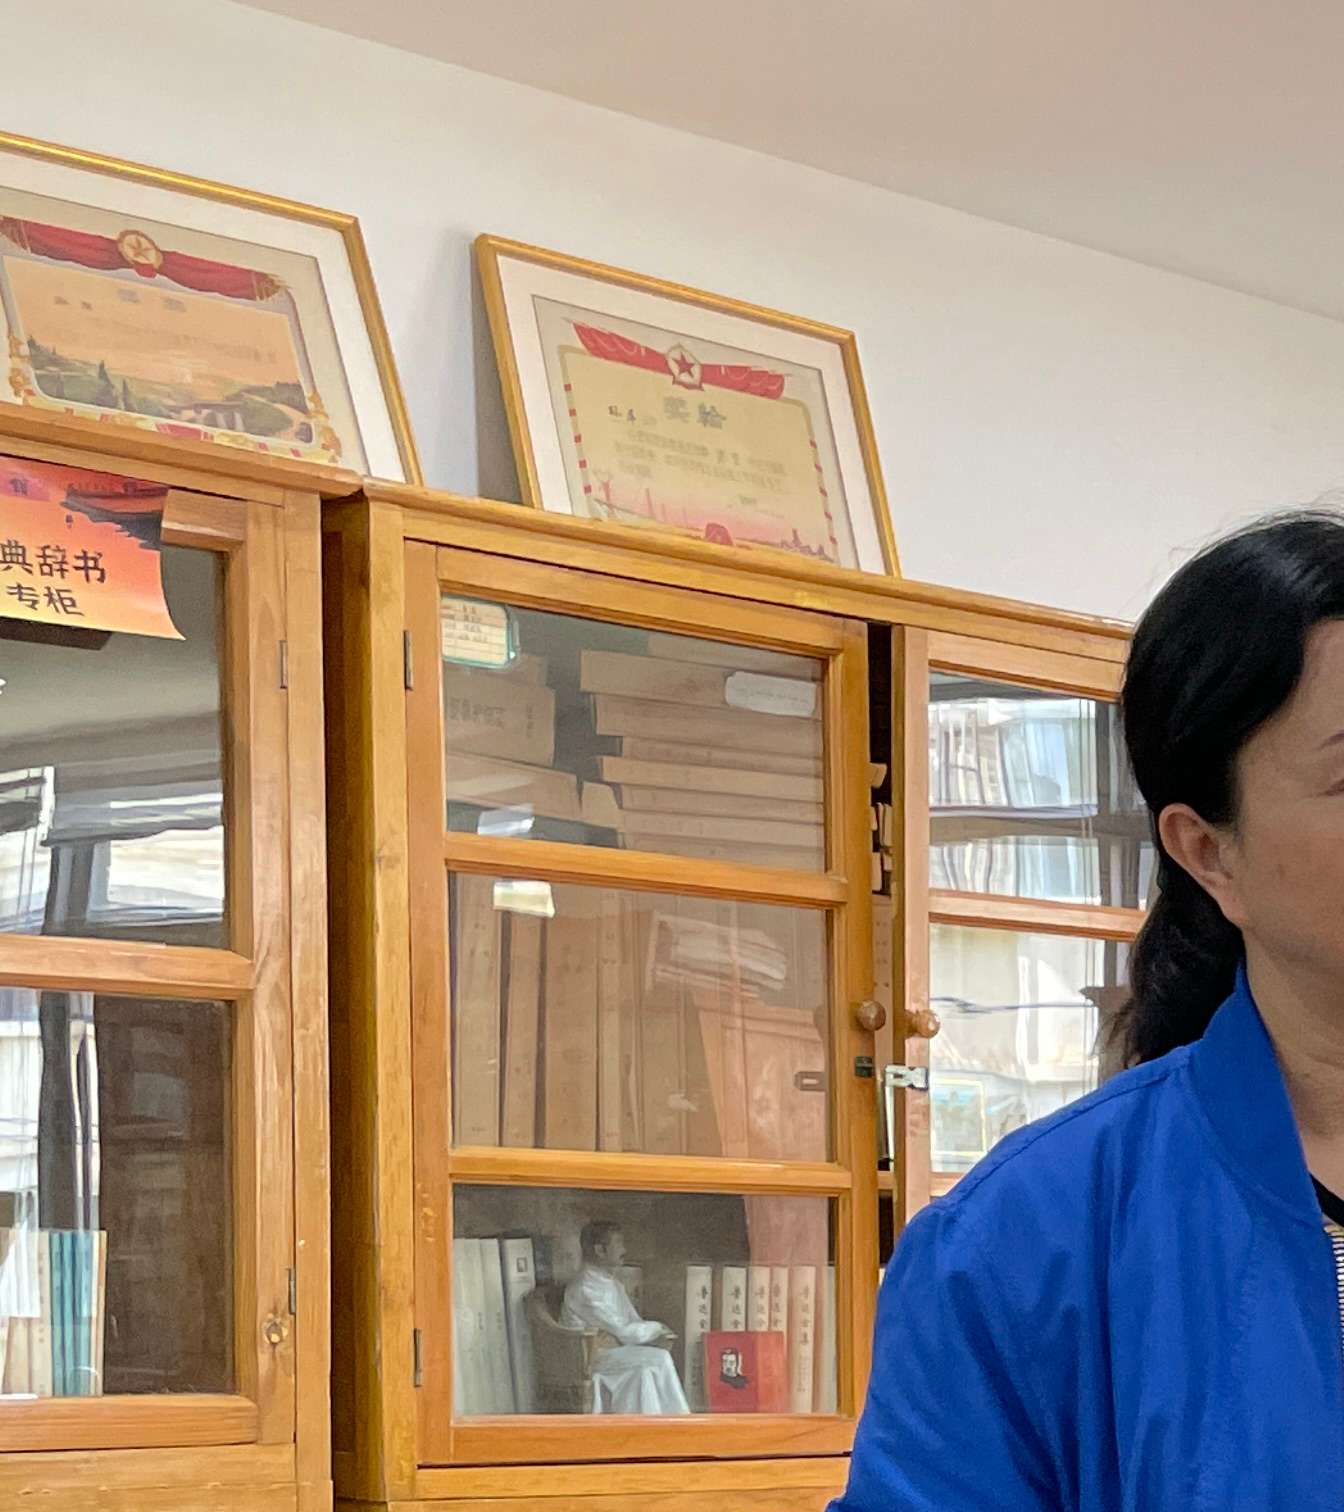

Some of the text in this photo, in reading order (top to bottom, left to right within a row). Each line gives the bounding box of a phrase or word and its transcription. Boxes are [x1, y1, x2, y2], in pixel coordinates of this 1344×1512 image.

[0, 539, 106, 584] 典辞书
[7, 583, 85, 617] 专柜
